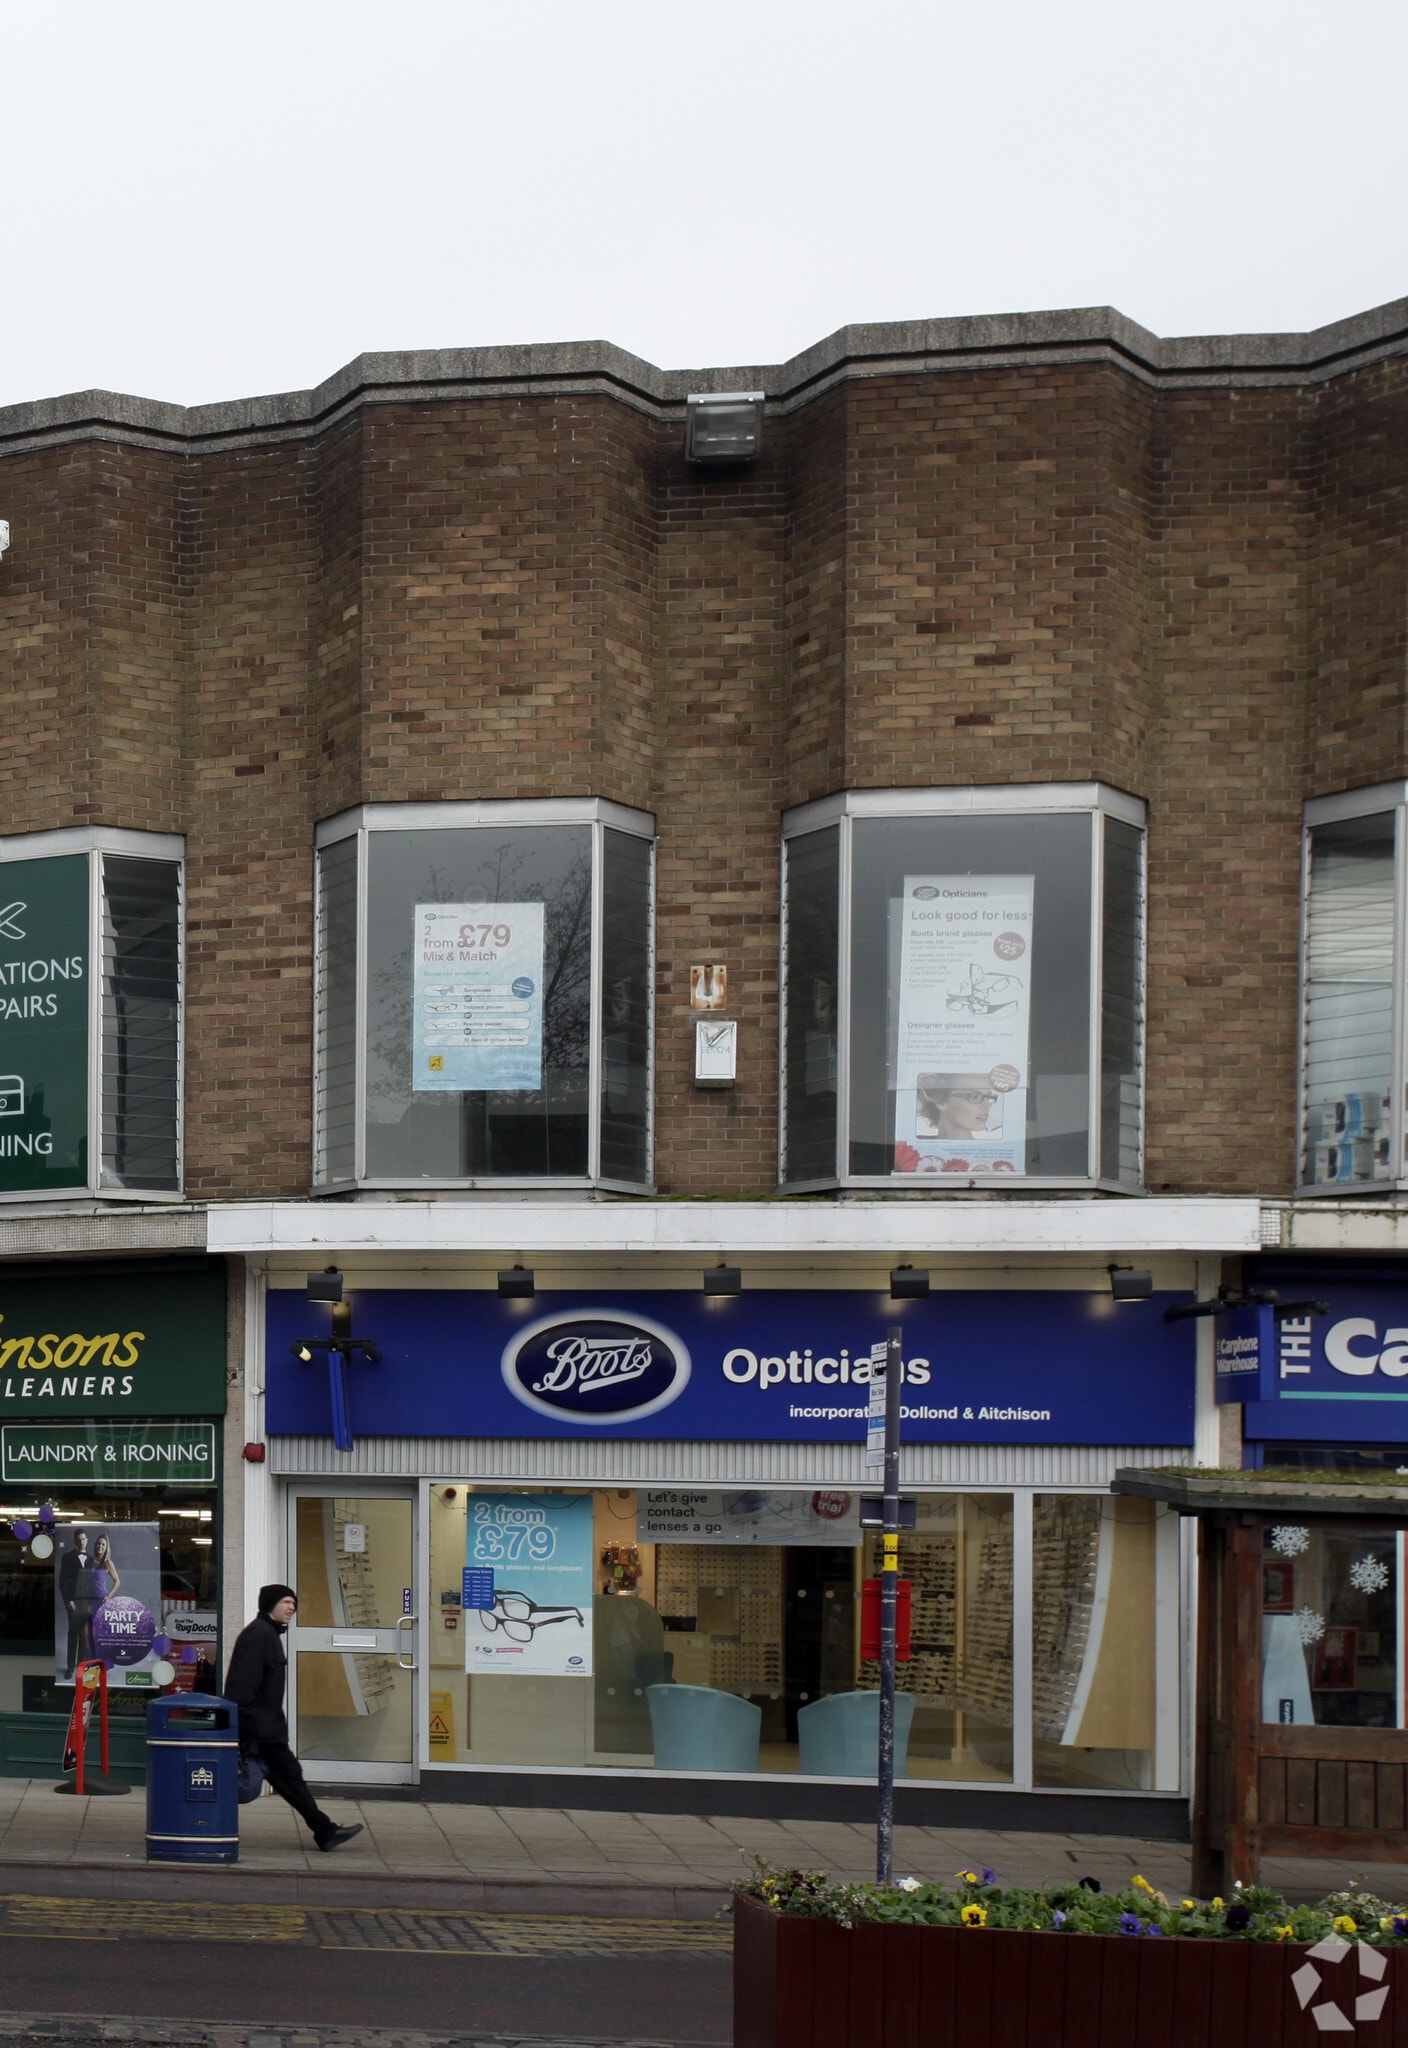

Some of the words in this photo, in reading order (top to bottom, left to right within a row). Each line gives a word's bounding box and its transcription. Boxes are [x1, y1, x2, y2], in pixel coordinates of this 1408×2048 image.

[942, 889, 988, 900] Opticians
[911, 910, 942, 920] Look
[945, 910, 978, 922] good
[982, 910, 999, 920] for
[424, 925, 432, 936] 2
[962, 930, 993, 938] glasses
[424, 937, 454, 948] from
[423, 951, 444, 961] Mix
[446, 951, 456, 961] &
[459, 950, 497, 961] Match
[907, 1021, 943, 1030] Designer
[944, 1021, 975, 1030] glasses
[0, 1132, 53, 1157] ING
[0, 1314, 145, 1369] nsons
[1220, 1336, 1259, 1356] Carphone
[1280, 1316, 1312, 1379] THE
[532, 1336, 653, 1393] Boots
[722, 1348, 931, 1390] Opticias
[1216, 1356, 1259, 1373] Warehouse
[0, 1375, 134, 1397] LEANERS
[790, 1405, 870, 1420] incorporat
[899, 1405, 958, 1420] Dollond
[963, 1407, 974, 1420] &
[978, 1405, 1051, 1420] Aitchison
[8, 1445, 98, 1462] LAUNDRY
[104, 1445, 117, 1462] &
[123, 1444, 208, 1461] IRONING
[647, 1491, 678, 1503] Let's
[681, 1492, 708, 1505] give
[820, 1491, 846, 1502] free
[647, 1507, 695, 1517] contact
[818, 1500, 843, 1513] trial
[474, 1502, 490, 1524] 2
[495, 1505, 546, 1525] from
[647, 1520, 689, 1532] lenses
[693, 1523, 701, 1532] a
[705, 1523, 722, 1534] go
[104, 1610, 144, 1622] PARTY
[108, 1622, 137, 1634] TIME
[192, 1623, 217, 1632] Docto
